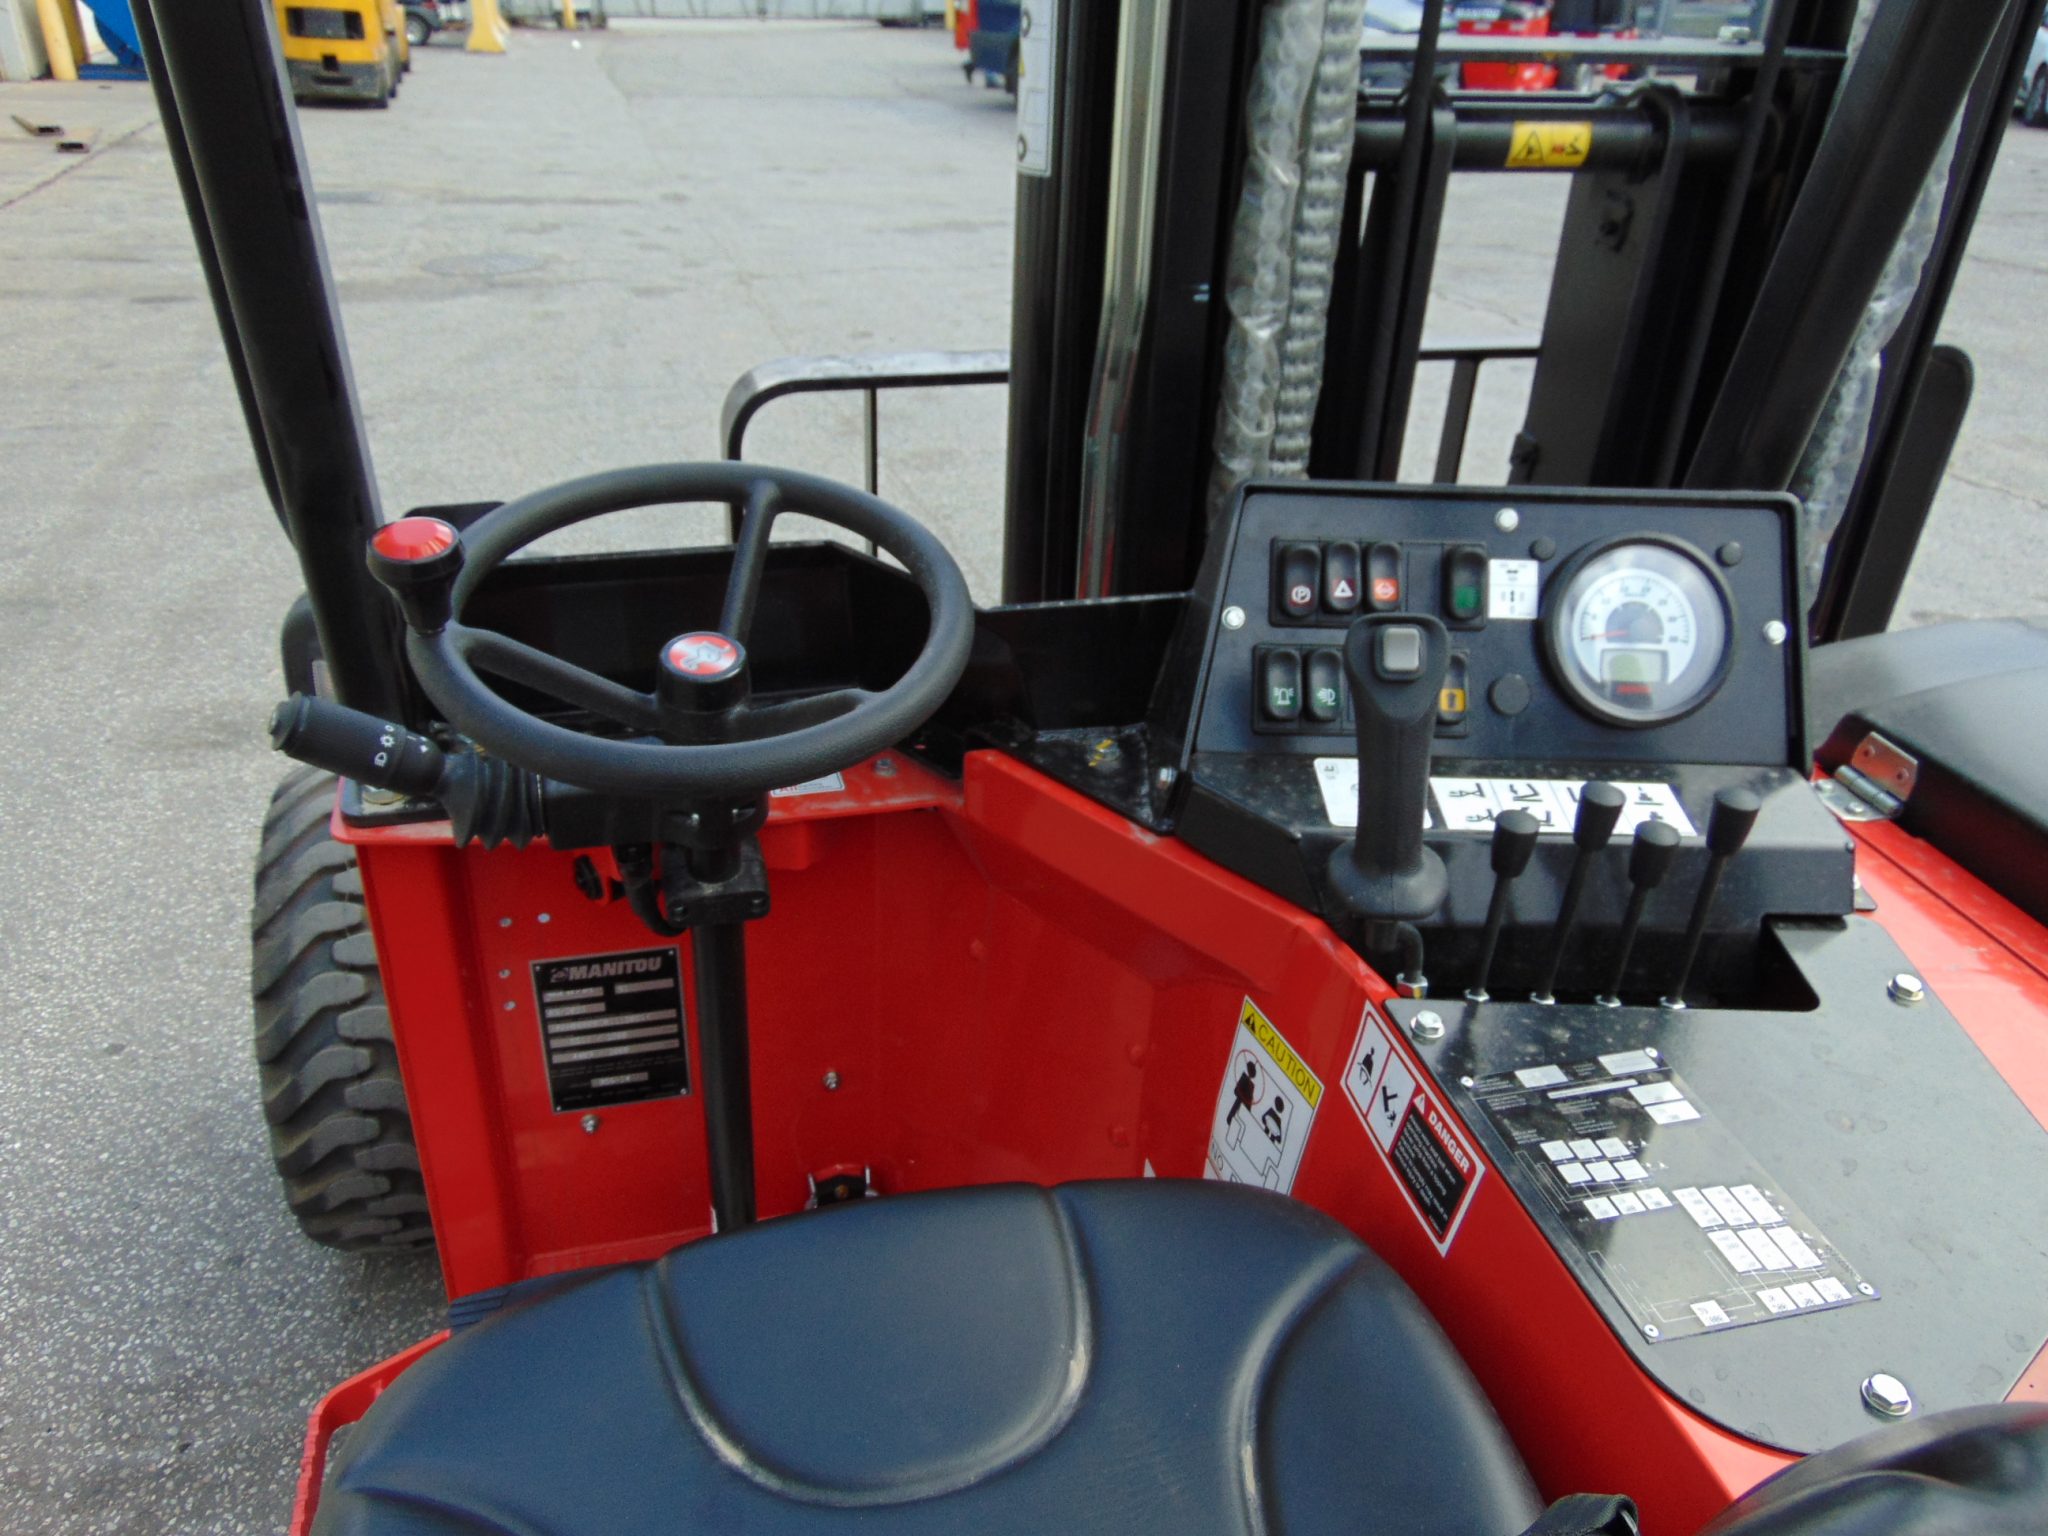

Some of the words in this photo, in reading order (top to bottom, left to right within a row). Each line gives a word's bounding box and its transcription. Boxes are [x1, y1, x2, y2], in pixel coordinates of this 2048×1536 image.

[569, 956, 662, 981] MANITOU
[1258, 1024, 1316, 1099] CAUTION
[1428, 1110, 1473, 1174] DANGER
